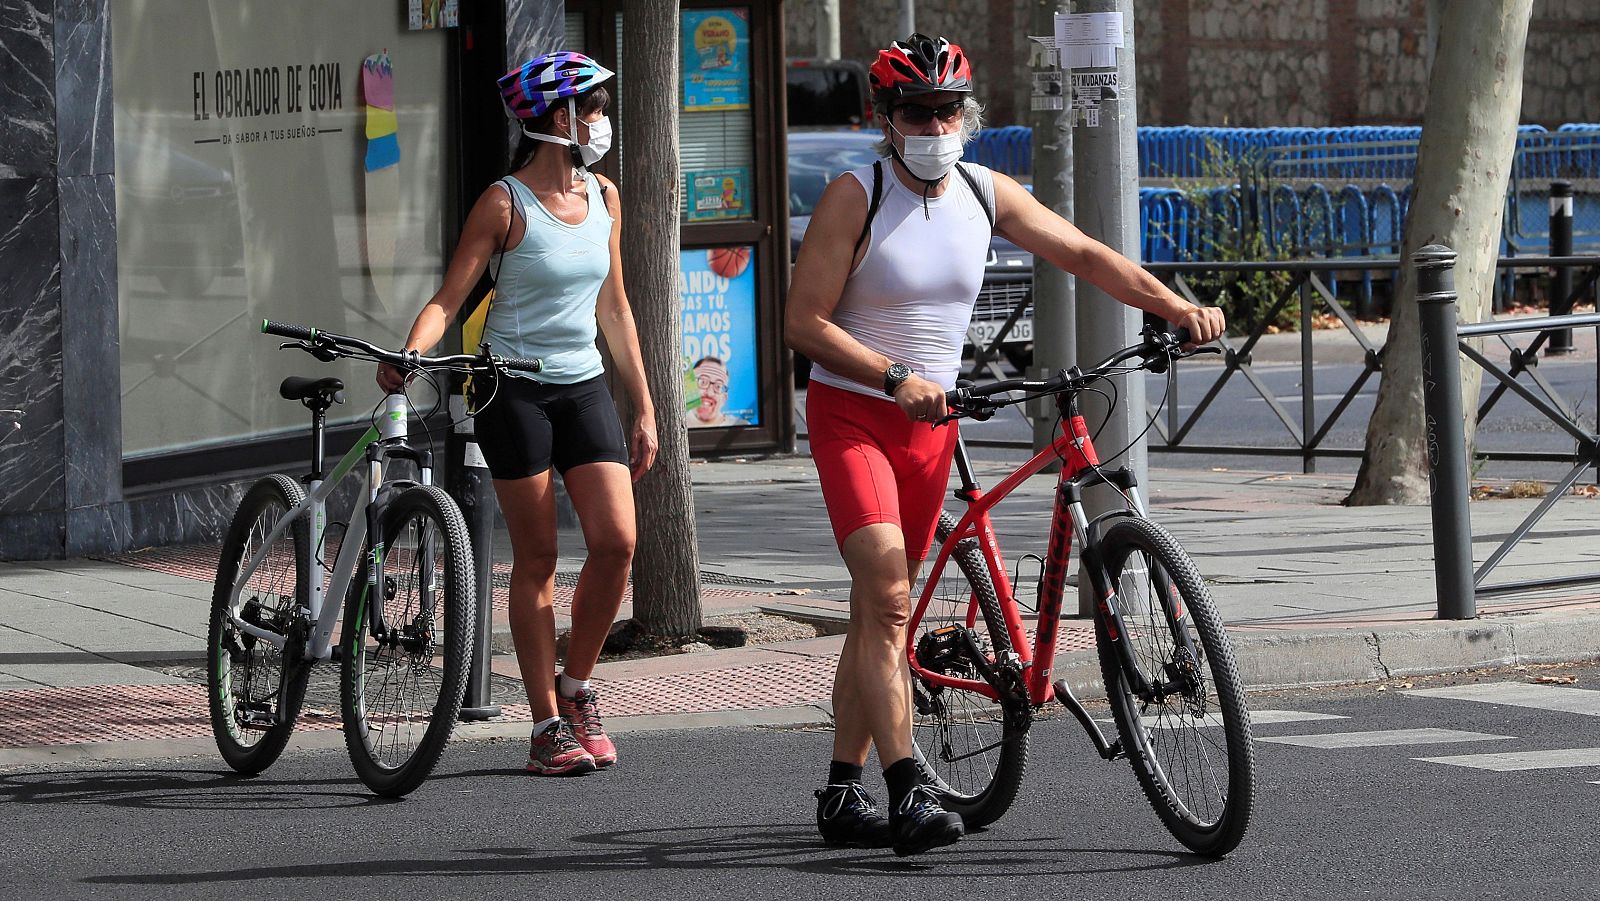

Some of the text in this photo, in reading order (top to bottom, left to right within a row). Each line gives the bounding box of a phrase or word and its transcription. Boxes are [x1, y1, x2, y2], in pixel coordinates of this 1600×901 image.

[1081, 73, 1117, 87] MUDANZAS
[193, 62, 342, 121] EL OBRADOR DE GOYA
[222, 125, 316, 145] DA SABOR A TUS SUEÑOS
[680, 311, 731, 333] AMOS
[971, 325, 996, 341] 92
[681, 333, 732, 363] DOS
